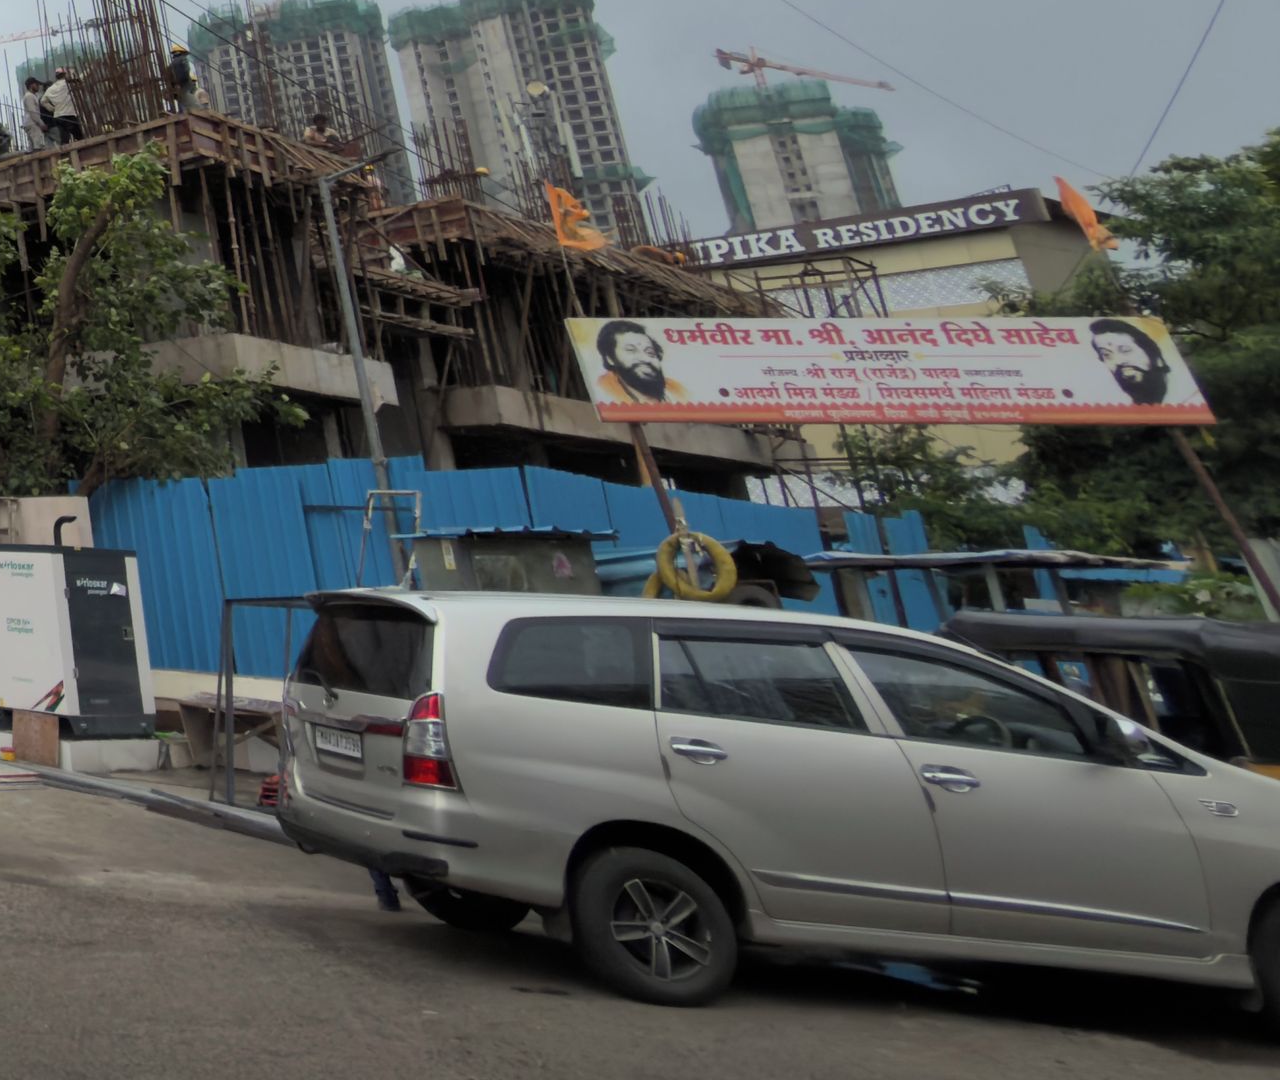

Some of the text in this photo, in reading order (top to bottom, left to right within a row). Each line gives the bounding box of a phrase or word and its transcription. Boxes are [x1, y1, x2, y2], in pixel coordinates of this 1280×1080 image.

[812, 199, 1020, 249] RESIDENCY
[663, 322, 753, 345] धर्मवीर
[808, 322, 856, 345] श्री.
[862, 322, 939, 347] आनंद
